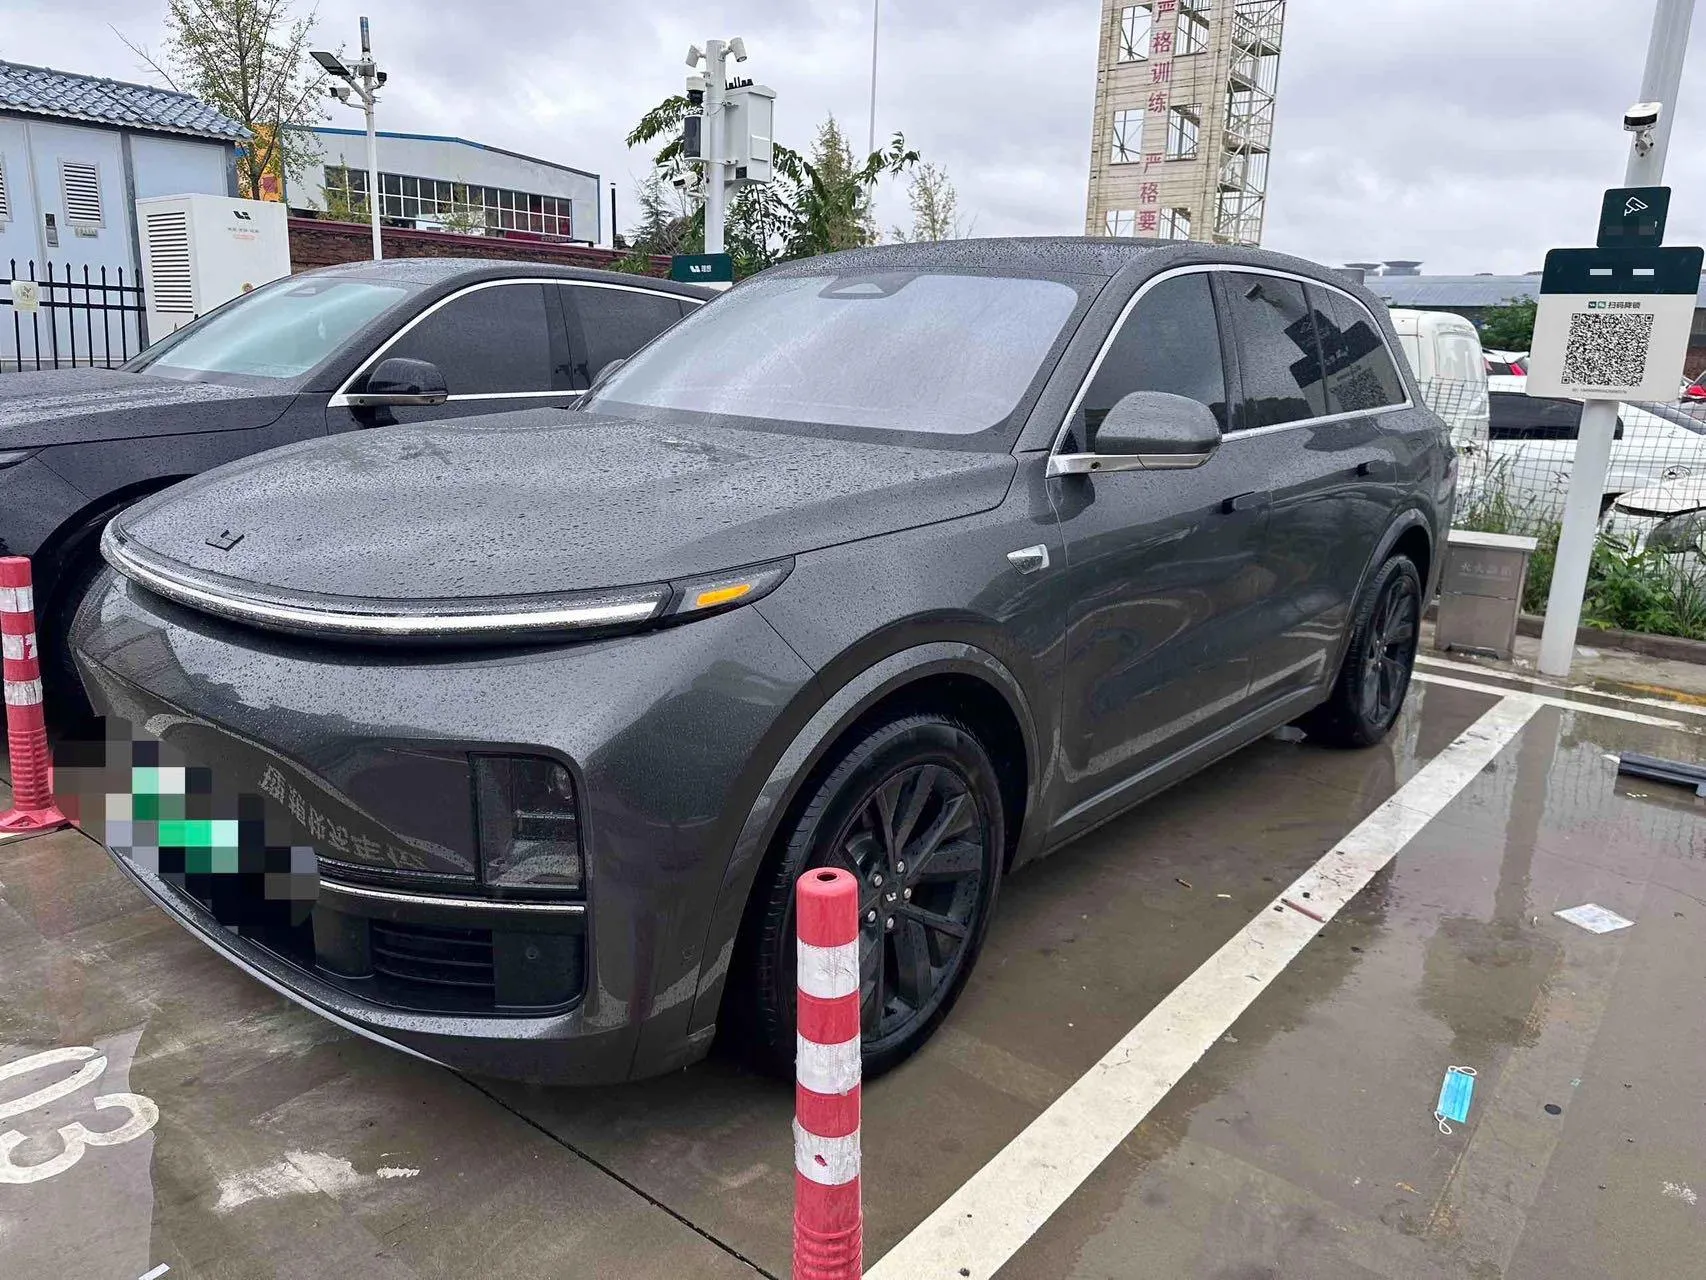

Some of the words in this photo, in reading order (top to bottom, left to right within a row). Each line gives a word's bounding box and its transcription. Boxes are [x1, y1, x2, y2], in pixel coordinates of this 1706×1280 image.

[1147, 0, 1176, 114] 严格训练
[1137, 152, 1163, 232] 严格要
